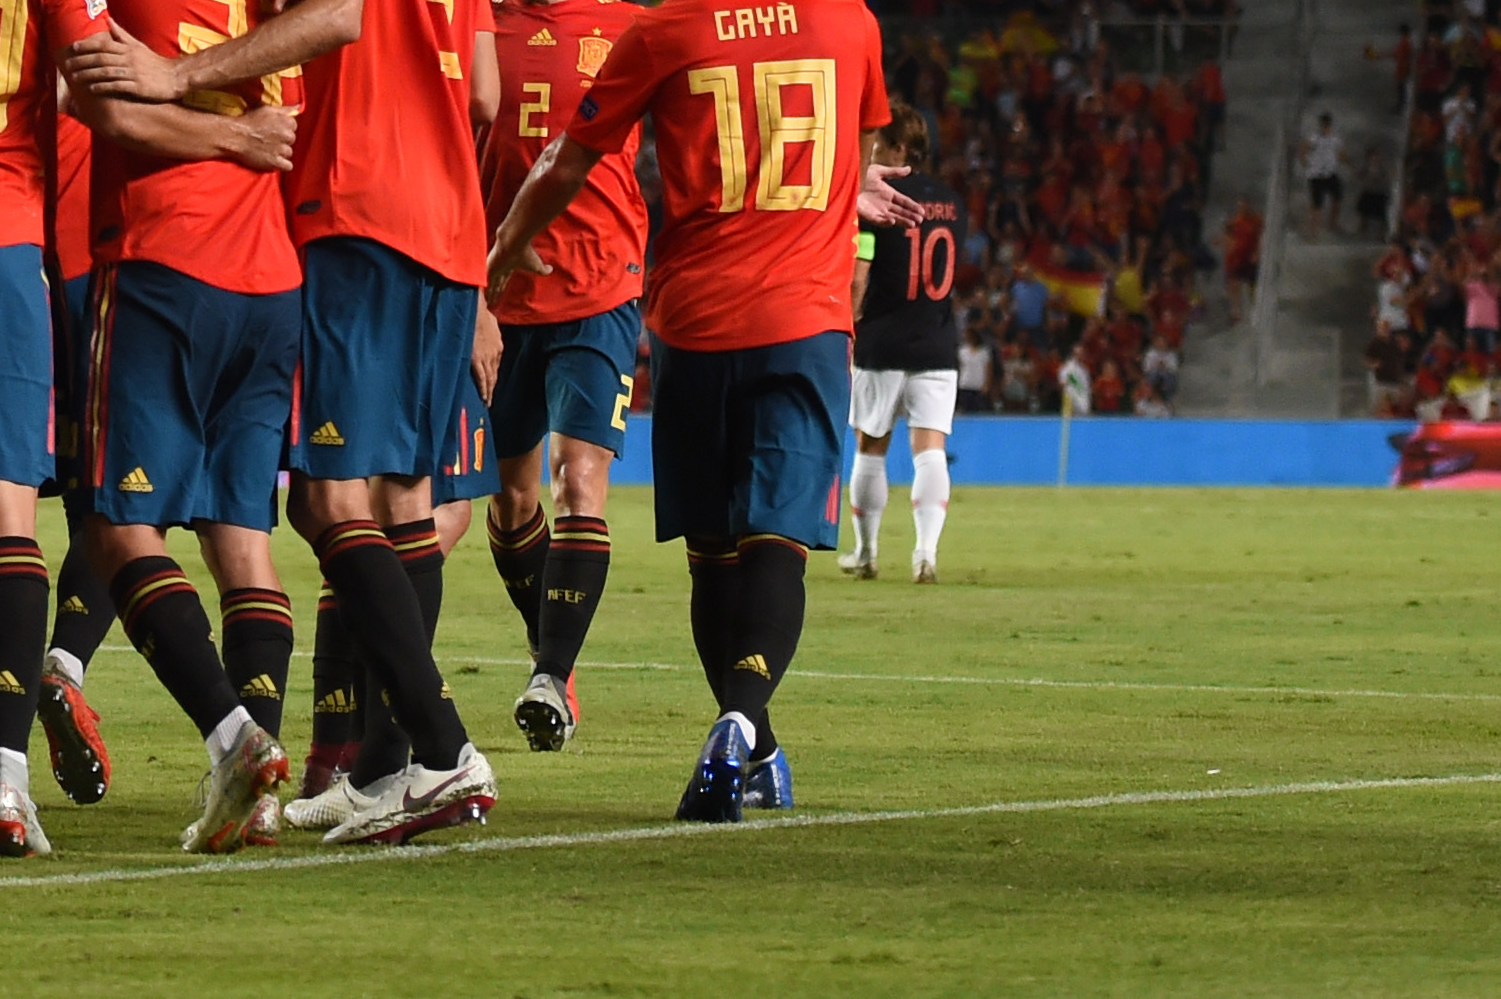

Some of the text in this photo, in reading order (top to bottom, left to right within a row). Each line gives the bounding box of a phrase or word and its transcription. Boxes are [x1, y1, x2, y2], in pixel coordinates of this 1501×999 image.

[519, 82, 551, 138] 2
[687, 58, 837, 214] 18
[904, 225, 956, 301] 10
[610, 373, 634, 433] 2
[309, 436, 345, 445] adidas
[239, 687, 281, 701] adidas
